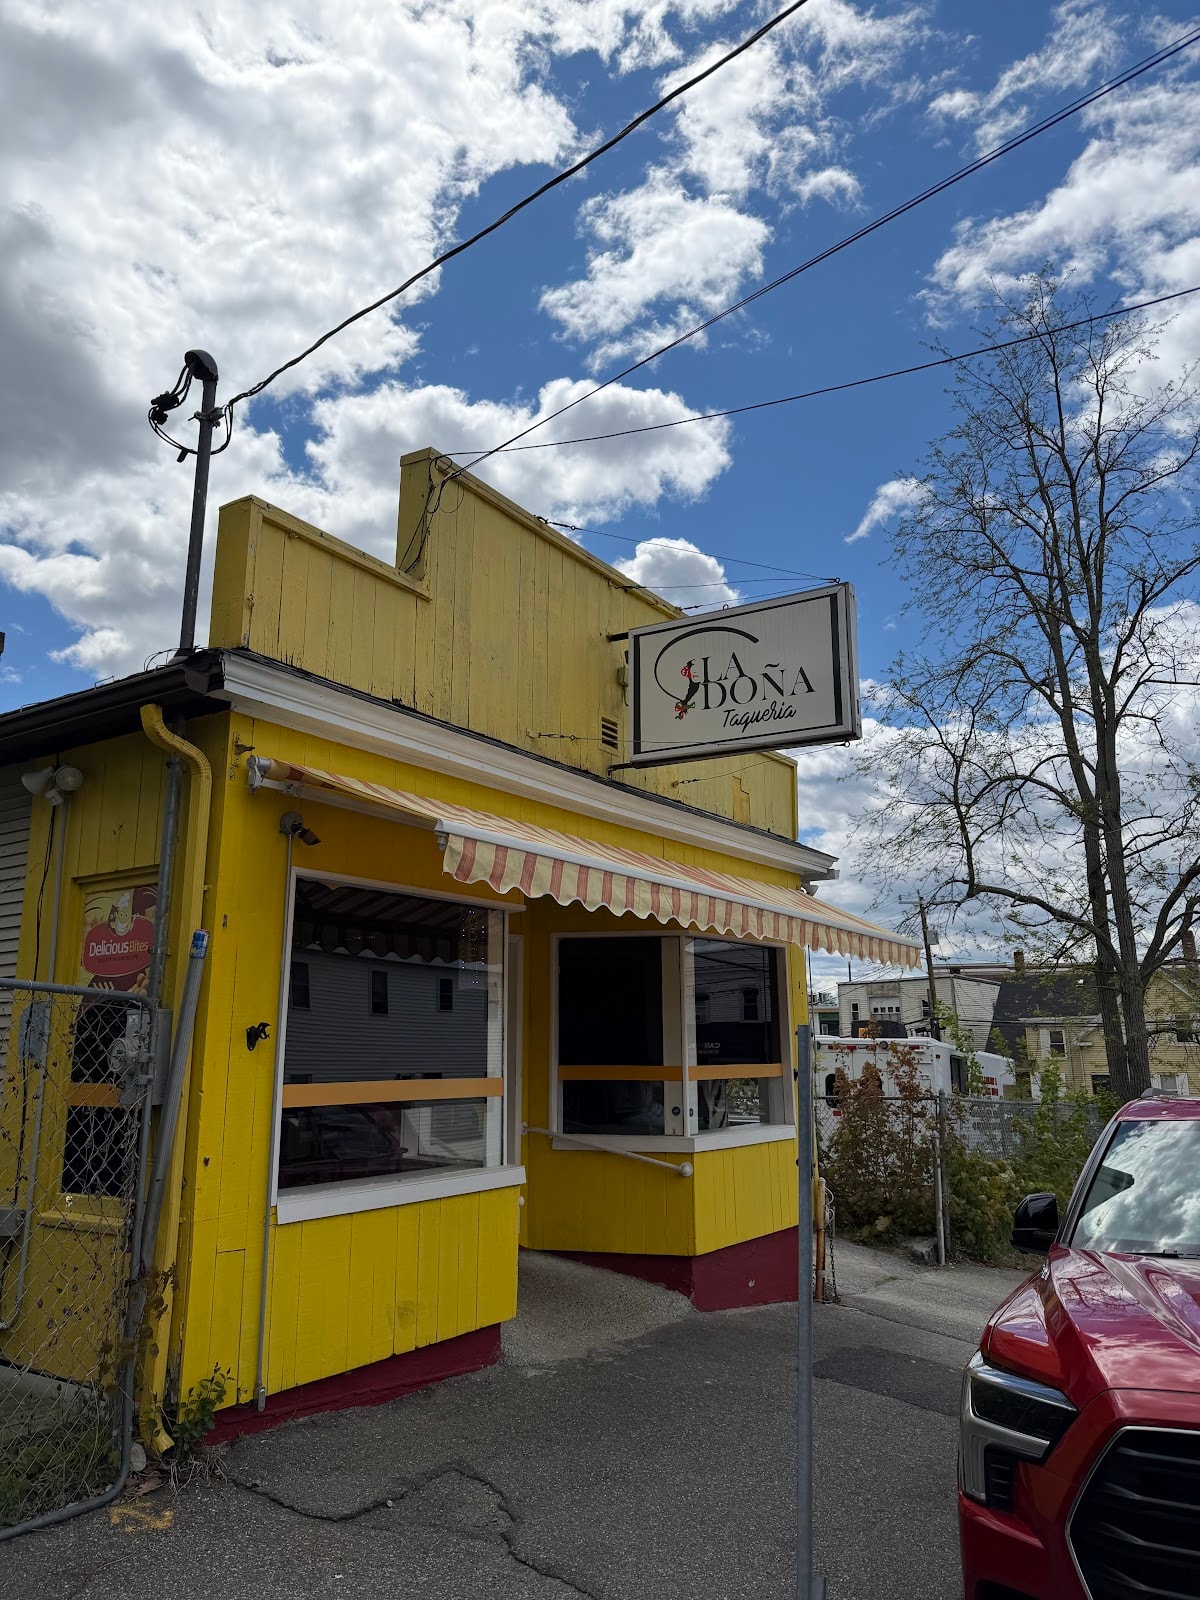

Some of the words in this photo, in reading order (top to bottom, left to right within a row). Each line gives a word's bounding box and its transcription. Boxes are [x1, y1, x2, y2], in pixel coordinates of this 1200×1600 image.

[700, 651, 745, 683] LA
[700, 662, 816, 710] DOÑA
[89, 940, 129, 956] Delicious
[129, 940, 149, 952] Bites
